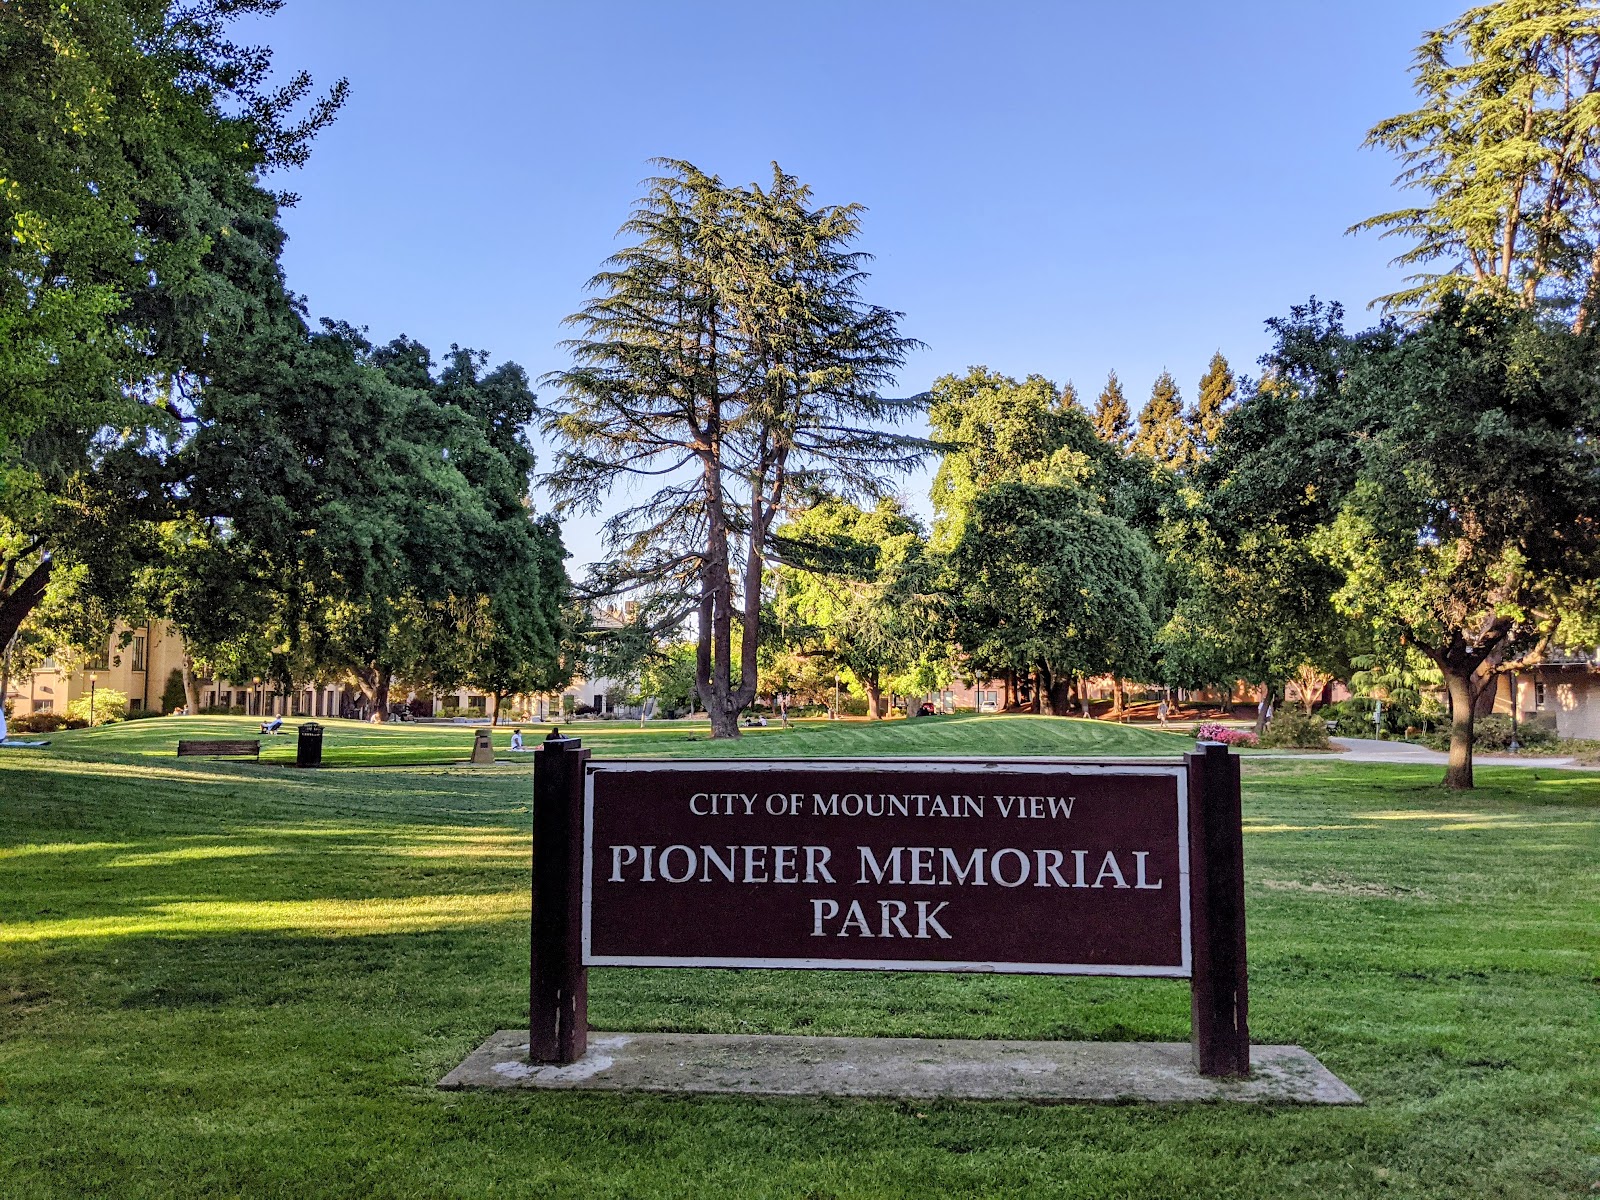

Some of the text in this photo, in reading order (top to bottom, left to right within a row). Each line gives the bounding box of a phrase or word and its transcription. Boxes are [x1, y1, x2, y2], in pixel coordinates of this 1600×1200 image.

[689, 793, 1075, 819] CITY OF MOUNTAIN VIEW
[607, 844, 1163, 890] PIONEER MEMORIAL
[809, 899, 954, 939] PARK
